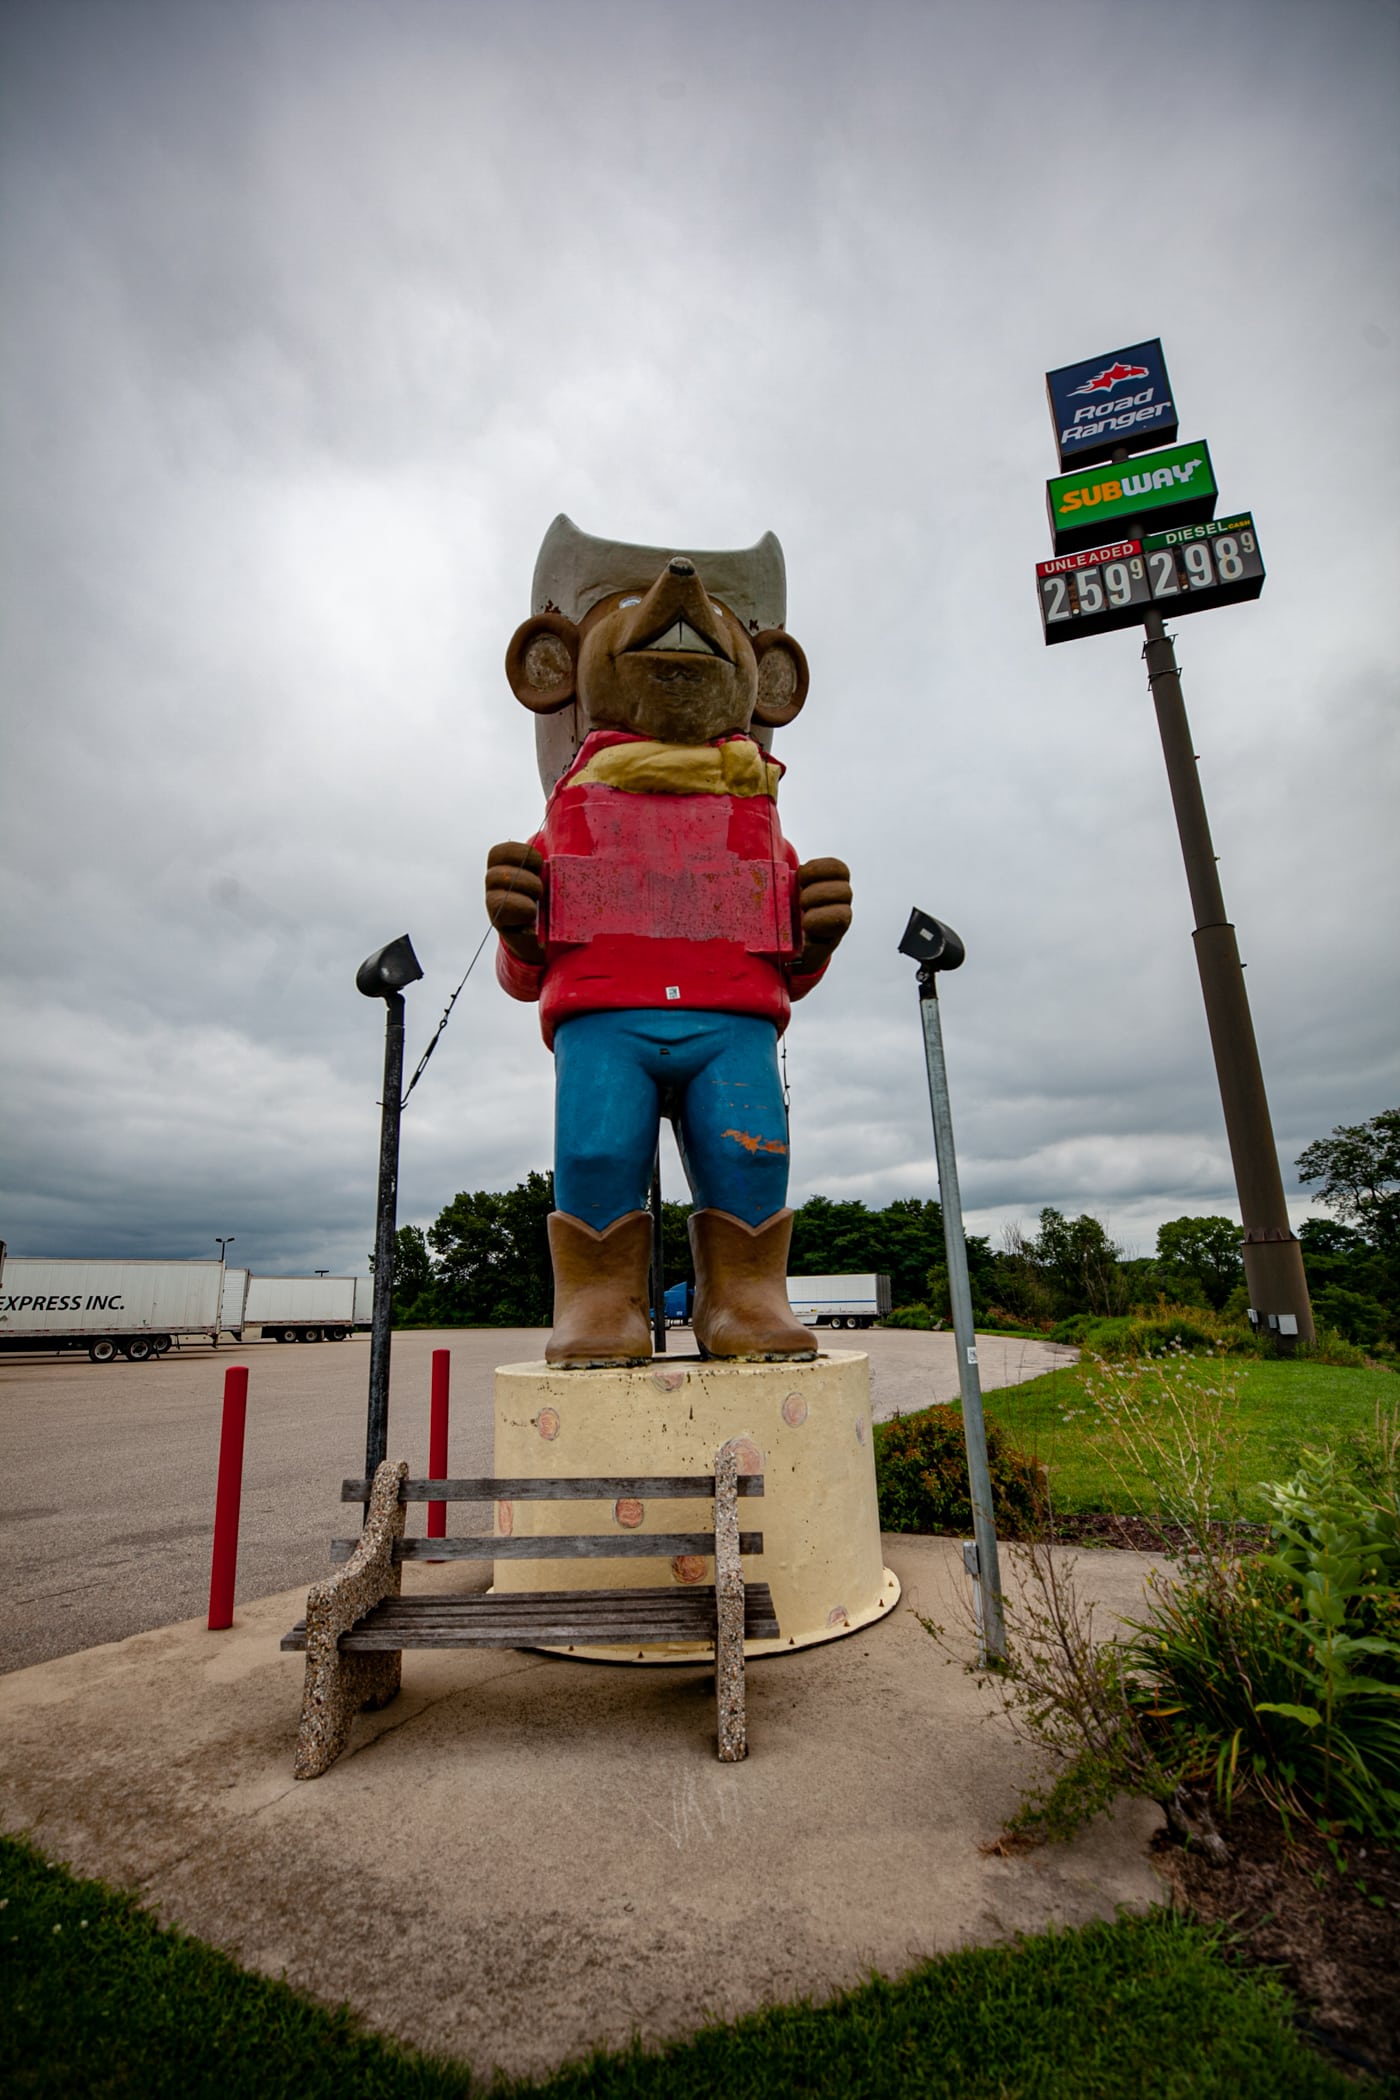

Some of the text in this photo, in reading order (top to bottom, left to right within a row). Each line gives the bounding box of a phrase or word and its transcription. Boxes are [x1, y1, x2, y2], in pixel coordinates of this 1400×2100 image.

[1061, 401, 1172, 444] Ranger
[1073, 387, 1154, 424] Road
[1058, 458, 1203, 514] SUBWAY
[1165, 519, 1251, 545] DIESEL CASH
[1044, 543, 1134, 574] UNLEADED
[85, 1295, 125, 1310] INC.
